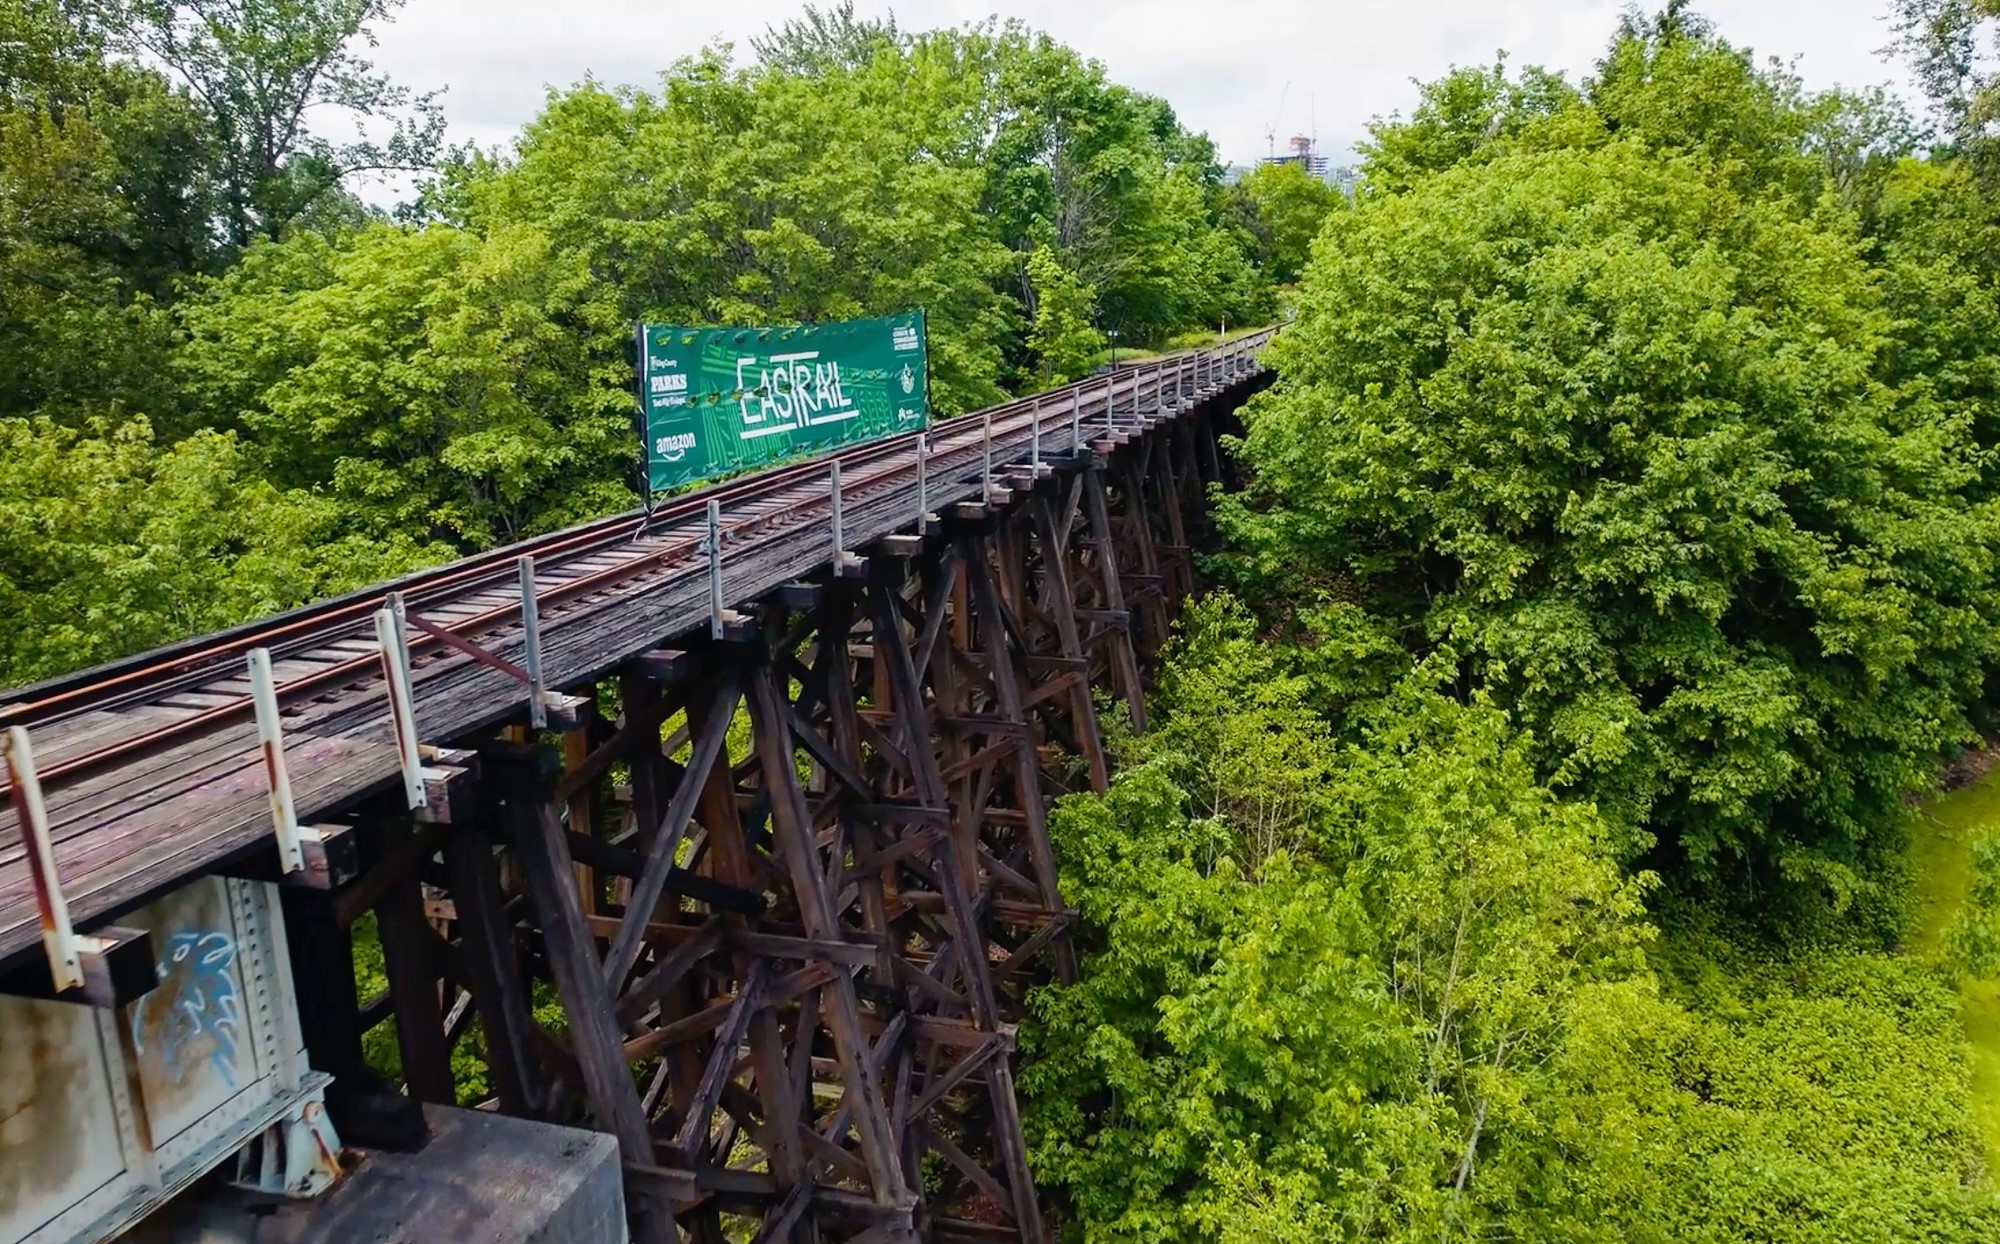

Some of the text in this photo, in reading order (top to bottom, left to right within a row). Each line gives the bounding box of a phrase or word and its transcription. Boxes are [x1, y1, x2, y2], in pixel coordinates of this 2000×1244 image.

[651, 374, 687, 392] PARKS
[737, 351, 852, 428] EASTRAIL
[656, 432, 696, 454] amazon
